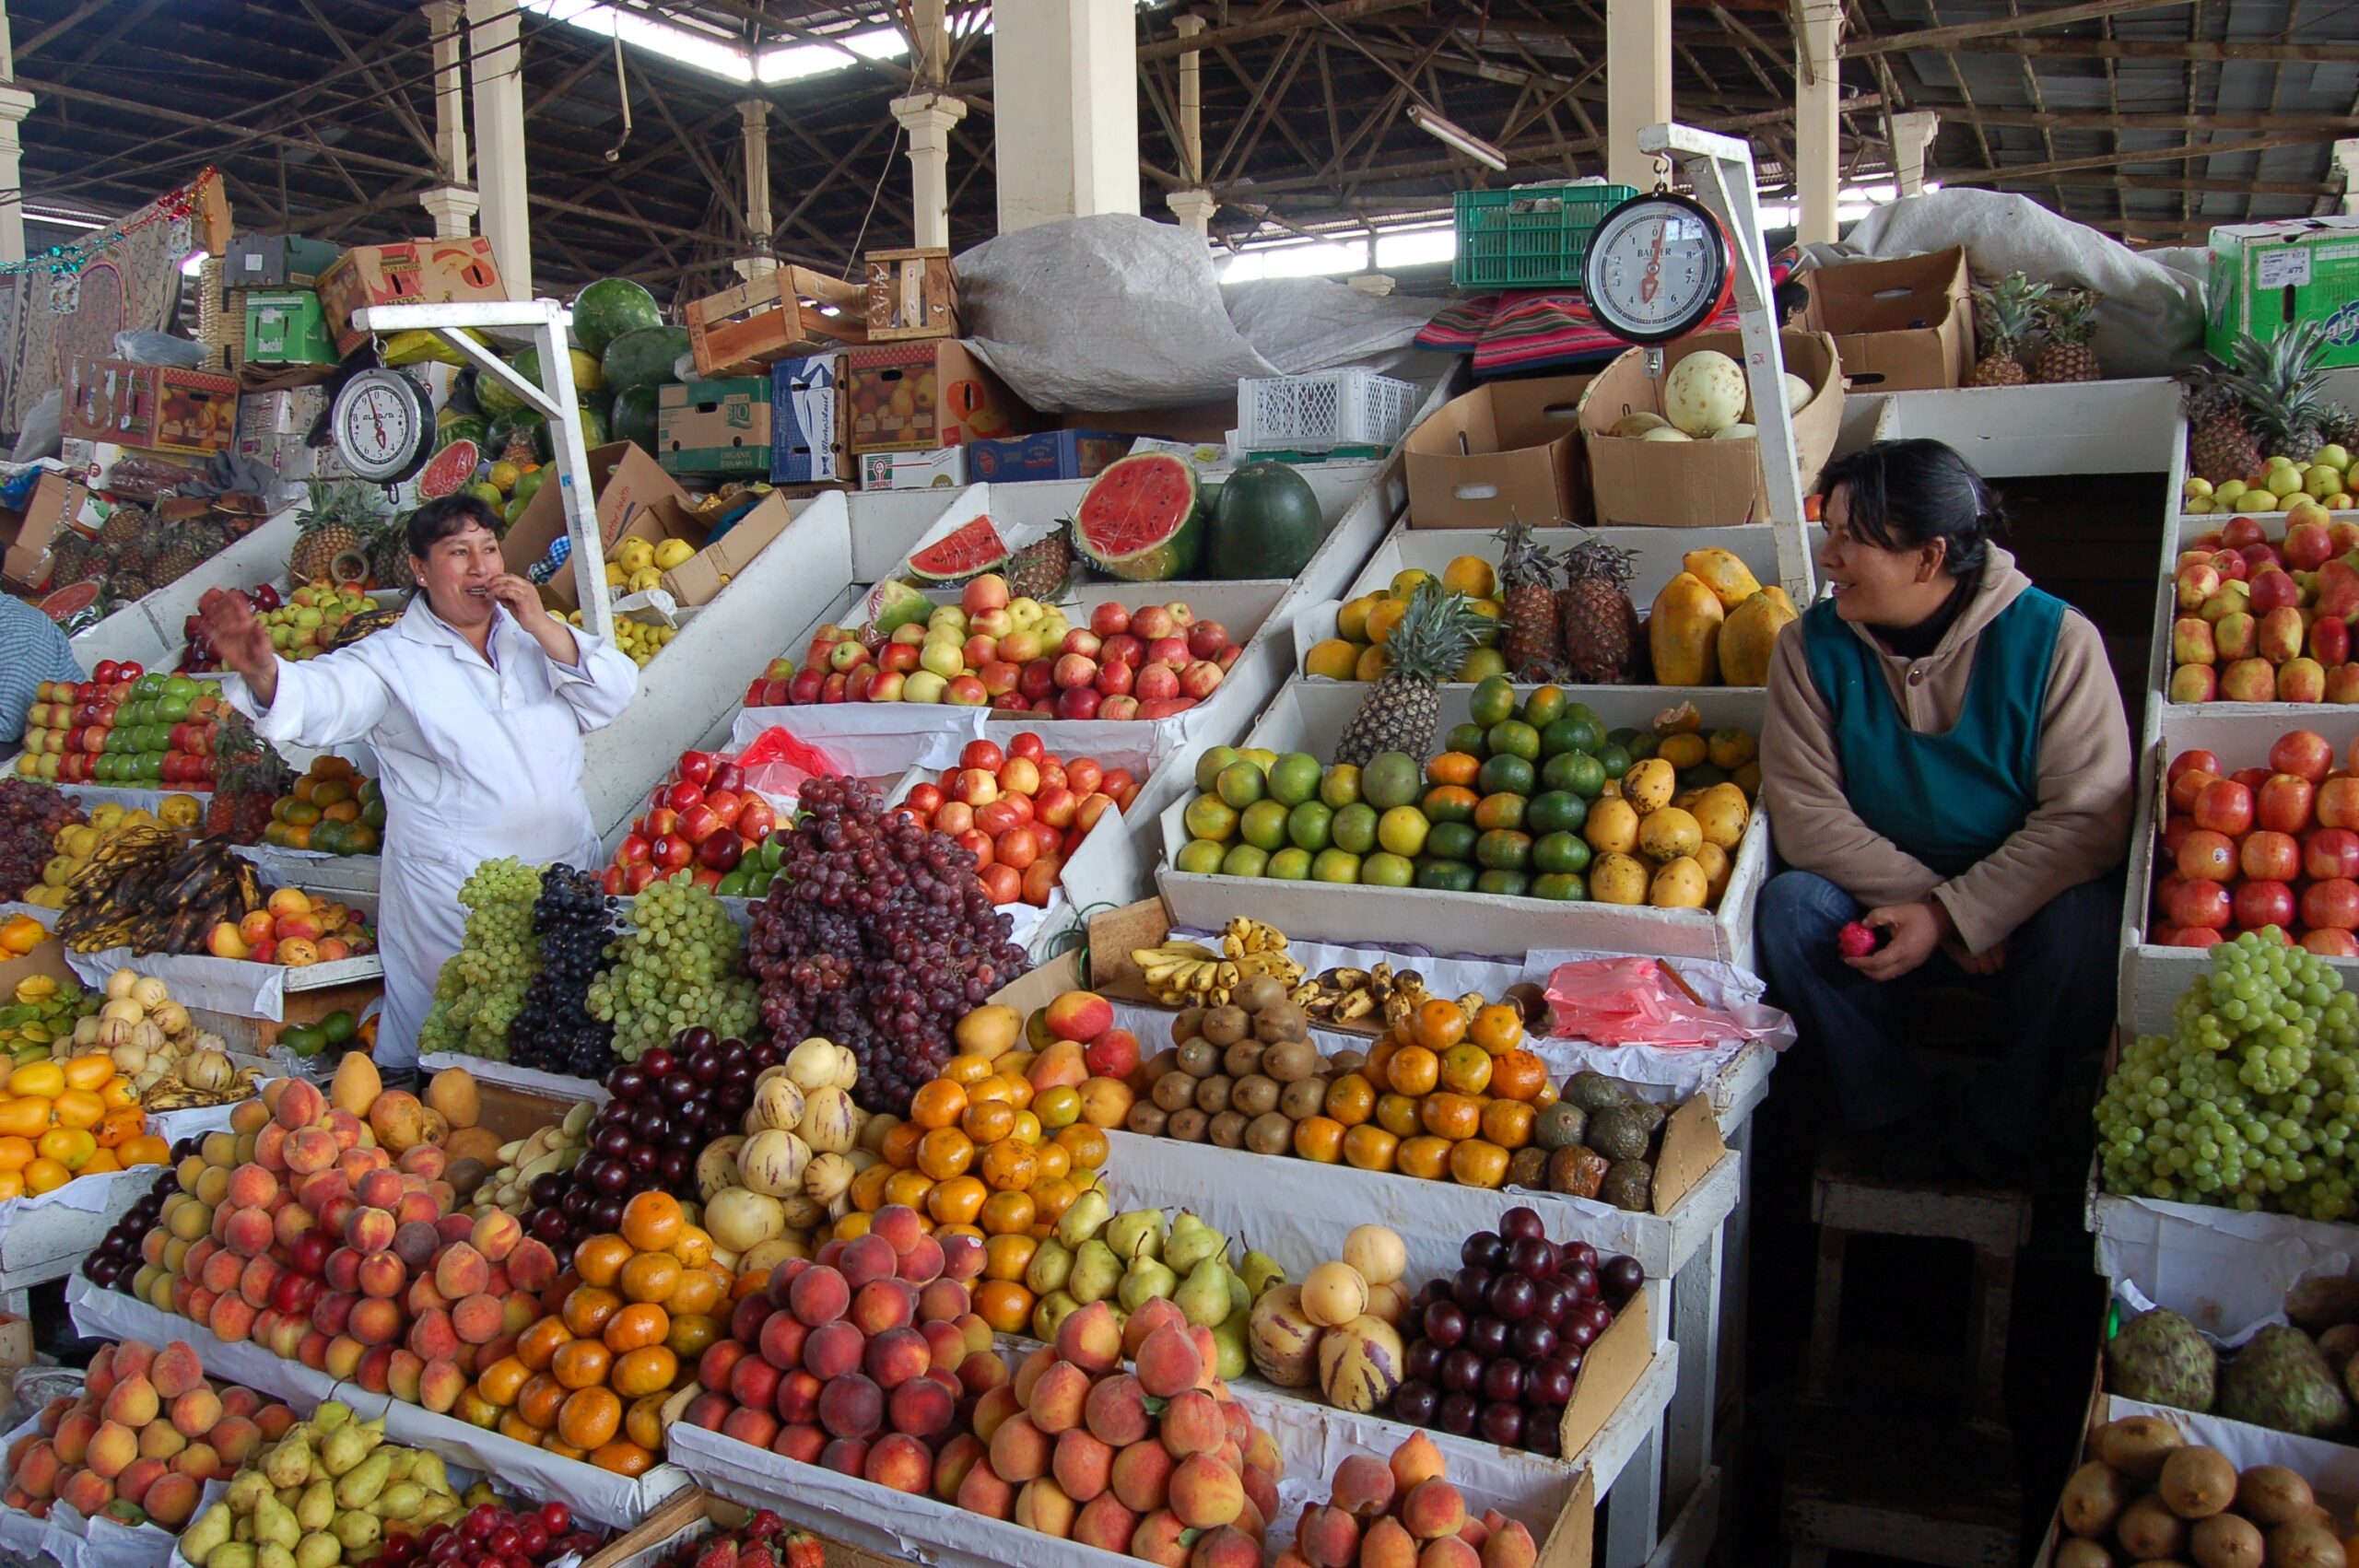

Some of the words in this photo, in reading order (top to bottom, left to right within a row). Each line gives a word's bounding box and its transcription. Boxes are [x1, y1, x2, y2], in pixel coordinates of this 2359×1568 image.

[1652, 228, 1659, 237] 0
[1637, 248, 1672, 257] BALER
[1686, 251, 1693, 260] 8
[1614, 256, 1622, 265] 2
[1614, 278, 1621, 287] 3
[1685, 275, 1692, 285] 7
[1628, 296, 1635, 305] 4
[1671, 294, 1677, 303] 6
[1649, 301, 1655, 310] 5
[374, 391, 381, 400] 0
[361, 397, 367, 406] 9
[398, 408, 404, 418] 2
[726, 404, 749, 421] BIO
[353, 413, 358, 422] 8
[399, 427, 405, 438] 3
[364, 447, 370, 455] 6
[378, 450, 382, 459] 5
